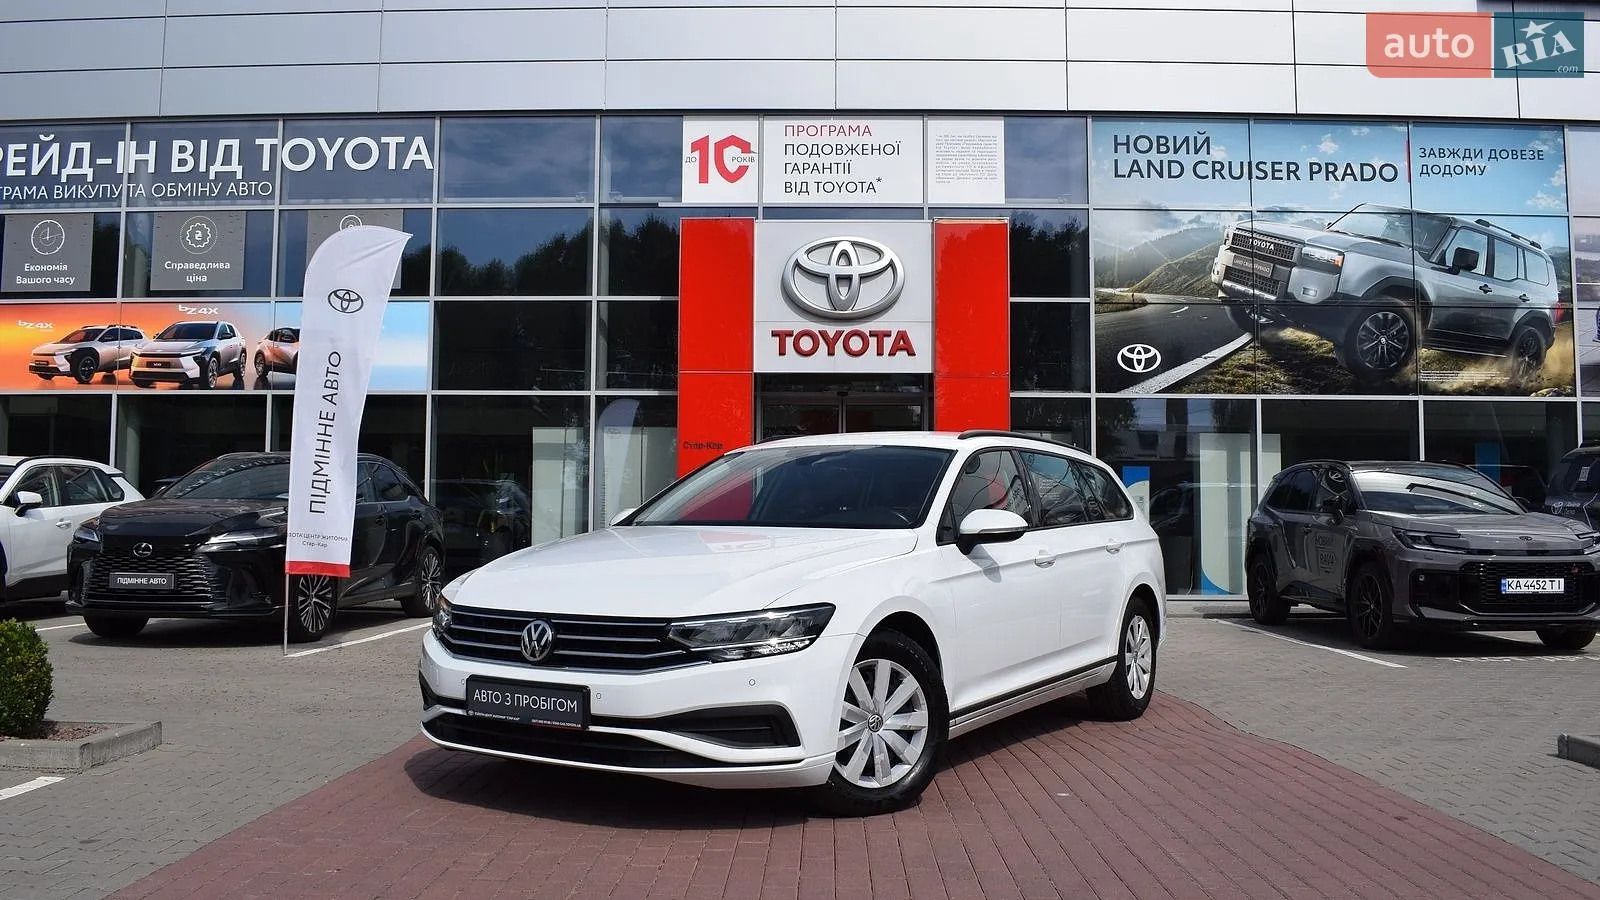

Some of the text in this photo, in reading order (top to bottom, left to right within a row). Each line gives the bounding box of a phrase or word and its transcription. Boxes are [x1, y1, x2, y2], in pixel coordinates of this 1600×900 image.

[784, 124, 872, 137] ПРОГРАМА
[784, 140, 901, 157] ПОДОВЖЕНОЇ
[1113, 130, 1211, 155] НОВИЙ
[0, 134, 434, 182] ЕЙД-ІН ВІД TOYOTA
[685, 156, 697, 165] ДО
[1418, 147, 1544, 163] ЗАВЖДИ ДОВЕЗЕ
[784, 161, 851, 175] ГАРАНТІЇ
[1113, 160, 1399, 183] LAND CRUISER PRADO
[1419, 163, 1487, 178] ДОДОМУ
[0, 181, 273, 199] РАМА ВИКУПУ ТА ОБМІНУ АВТО
[784, 181, 809, 196] ВІД
[24, 263, 68, 271] Економія
[164, 260, 231, 271] Справедлива
[16, 275, 75, 285] Вашого часу
[186, 273, 207, 283] ціна
[771, 329, 917, 357] TOYOTA
[309, 351, 342, 514] ПІДМІННЕ АВТО
[116, 577, 167, 585] ПІДМІННЕ АВТО
[1507, 580, 1561, 590] KA 4452 TI
[473, 689, 502, 704] АВТО
[514, 694, 578, 713] ПРОБІГОМ
